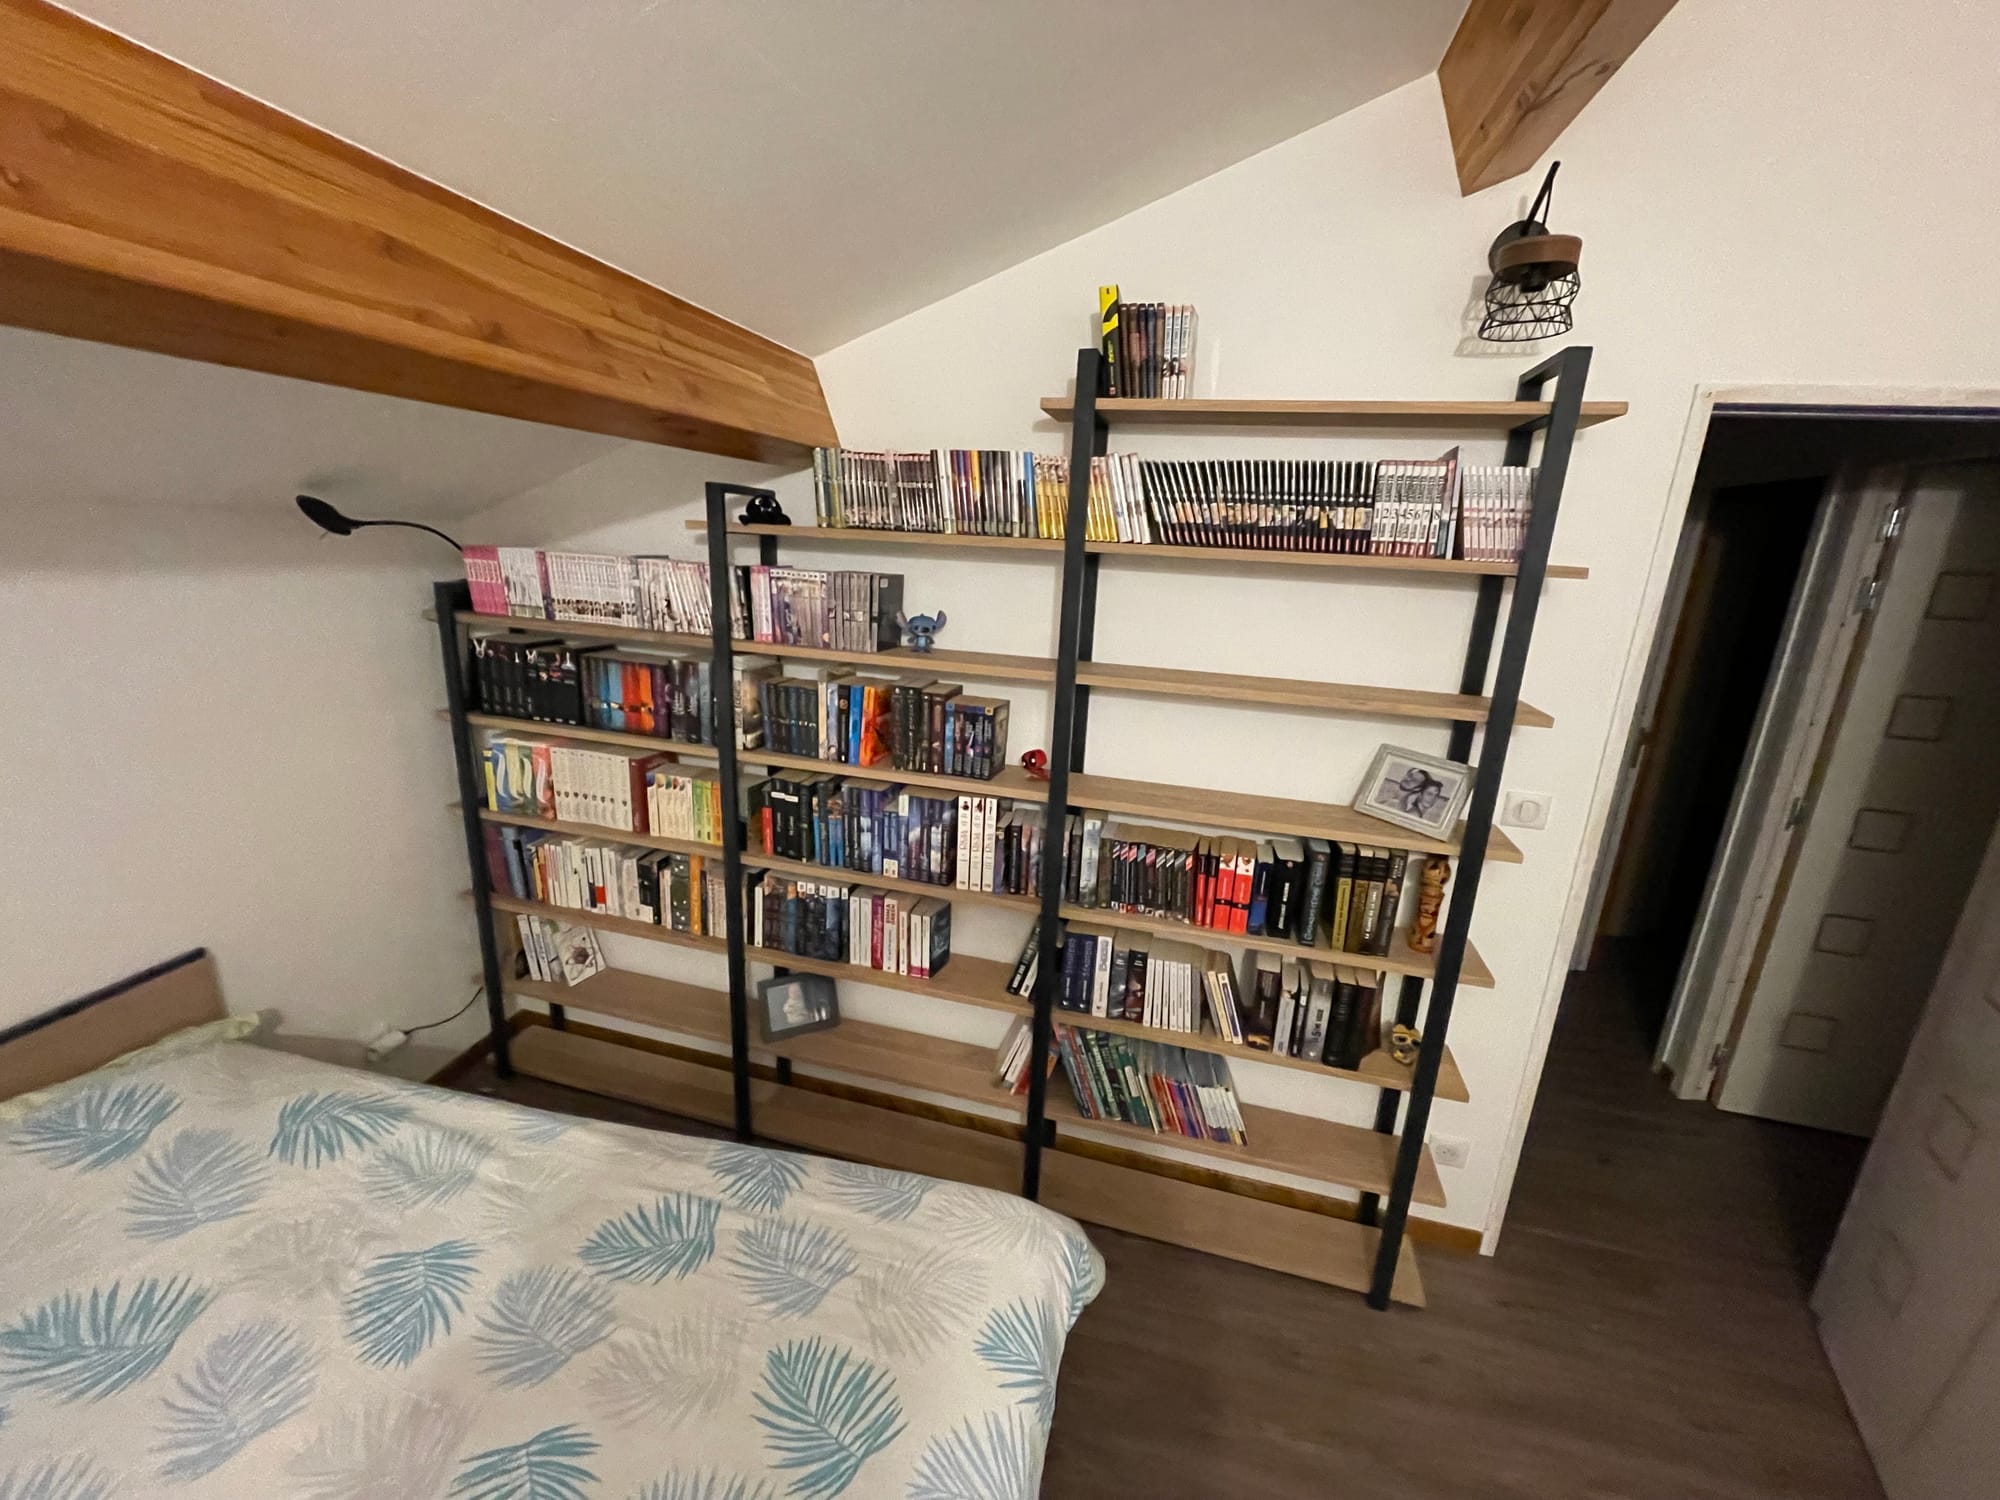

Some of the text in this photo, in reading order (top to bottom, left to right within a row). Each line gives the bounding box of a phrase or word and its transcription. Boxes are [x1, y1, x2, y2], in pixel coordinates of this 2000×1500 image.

[1382, 508, 1389, 519] 2
[1400, 508, 1407, 519] 4
[1406, 509, 1413, 519] 5
[1414, 510, 1421, 520] 6
[1423, 509, 1430, 520] 7
[1433, 510, 1441, 521] 8
